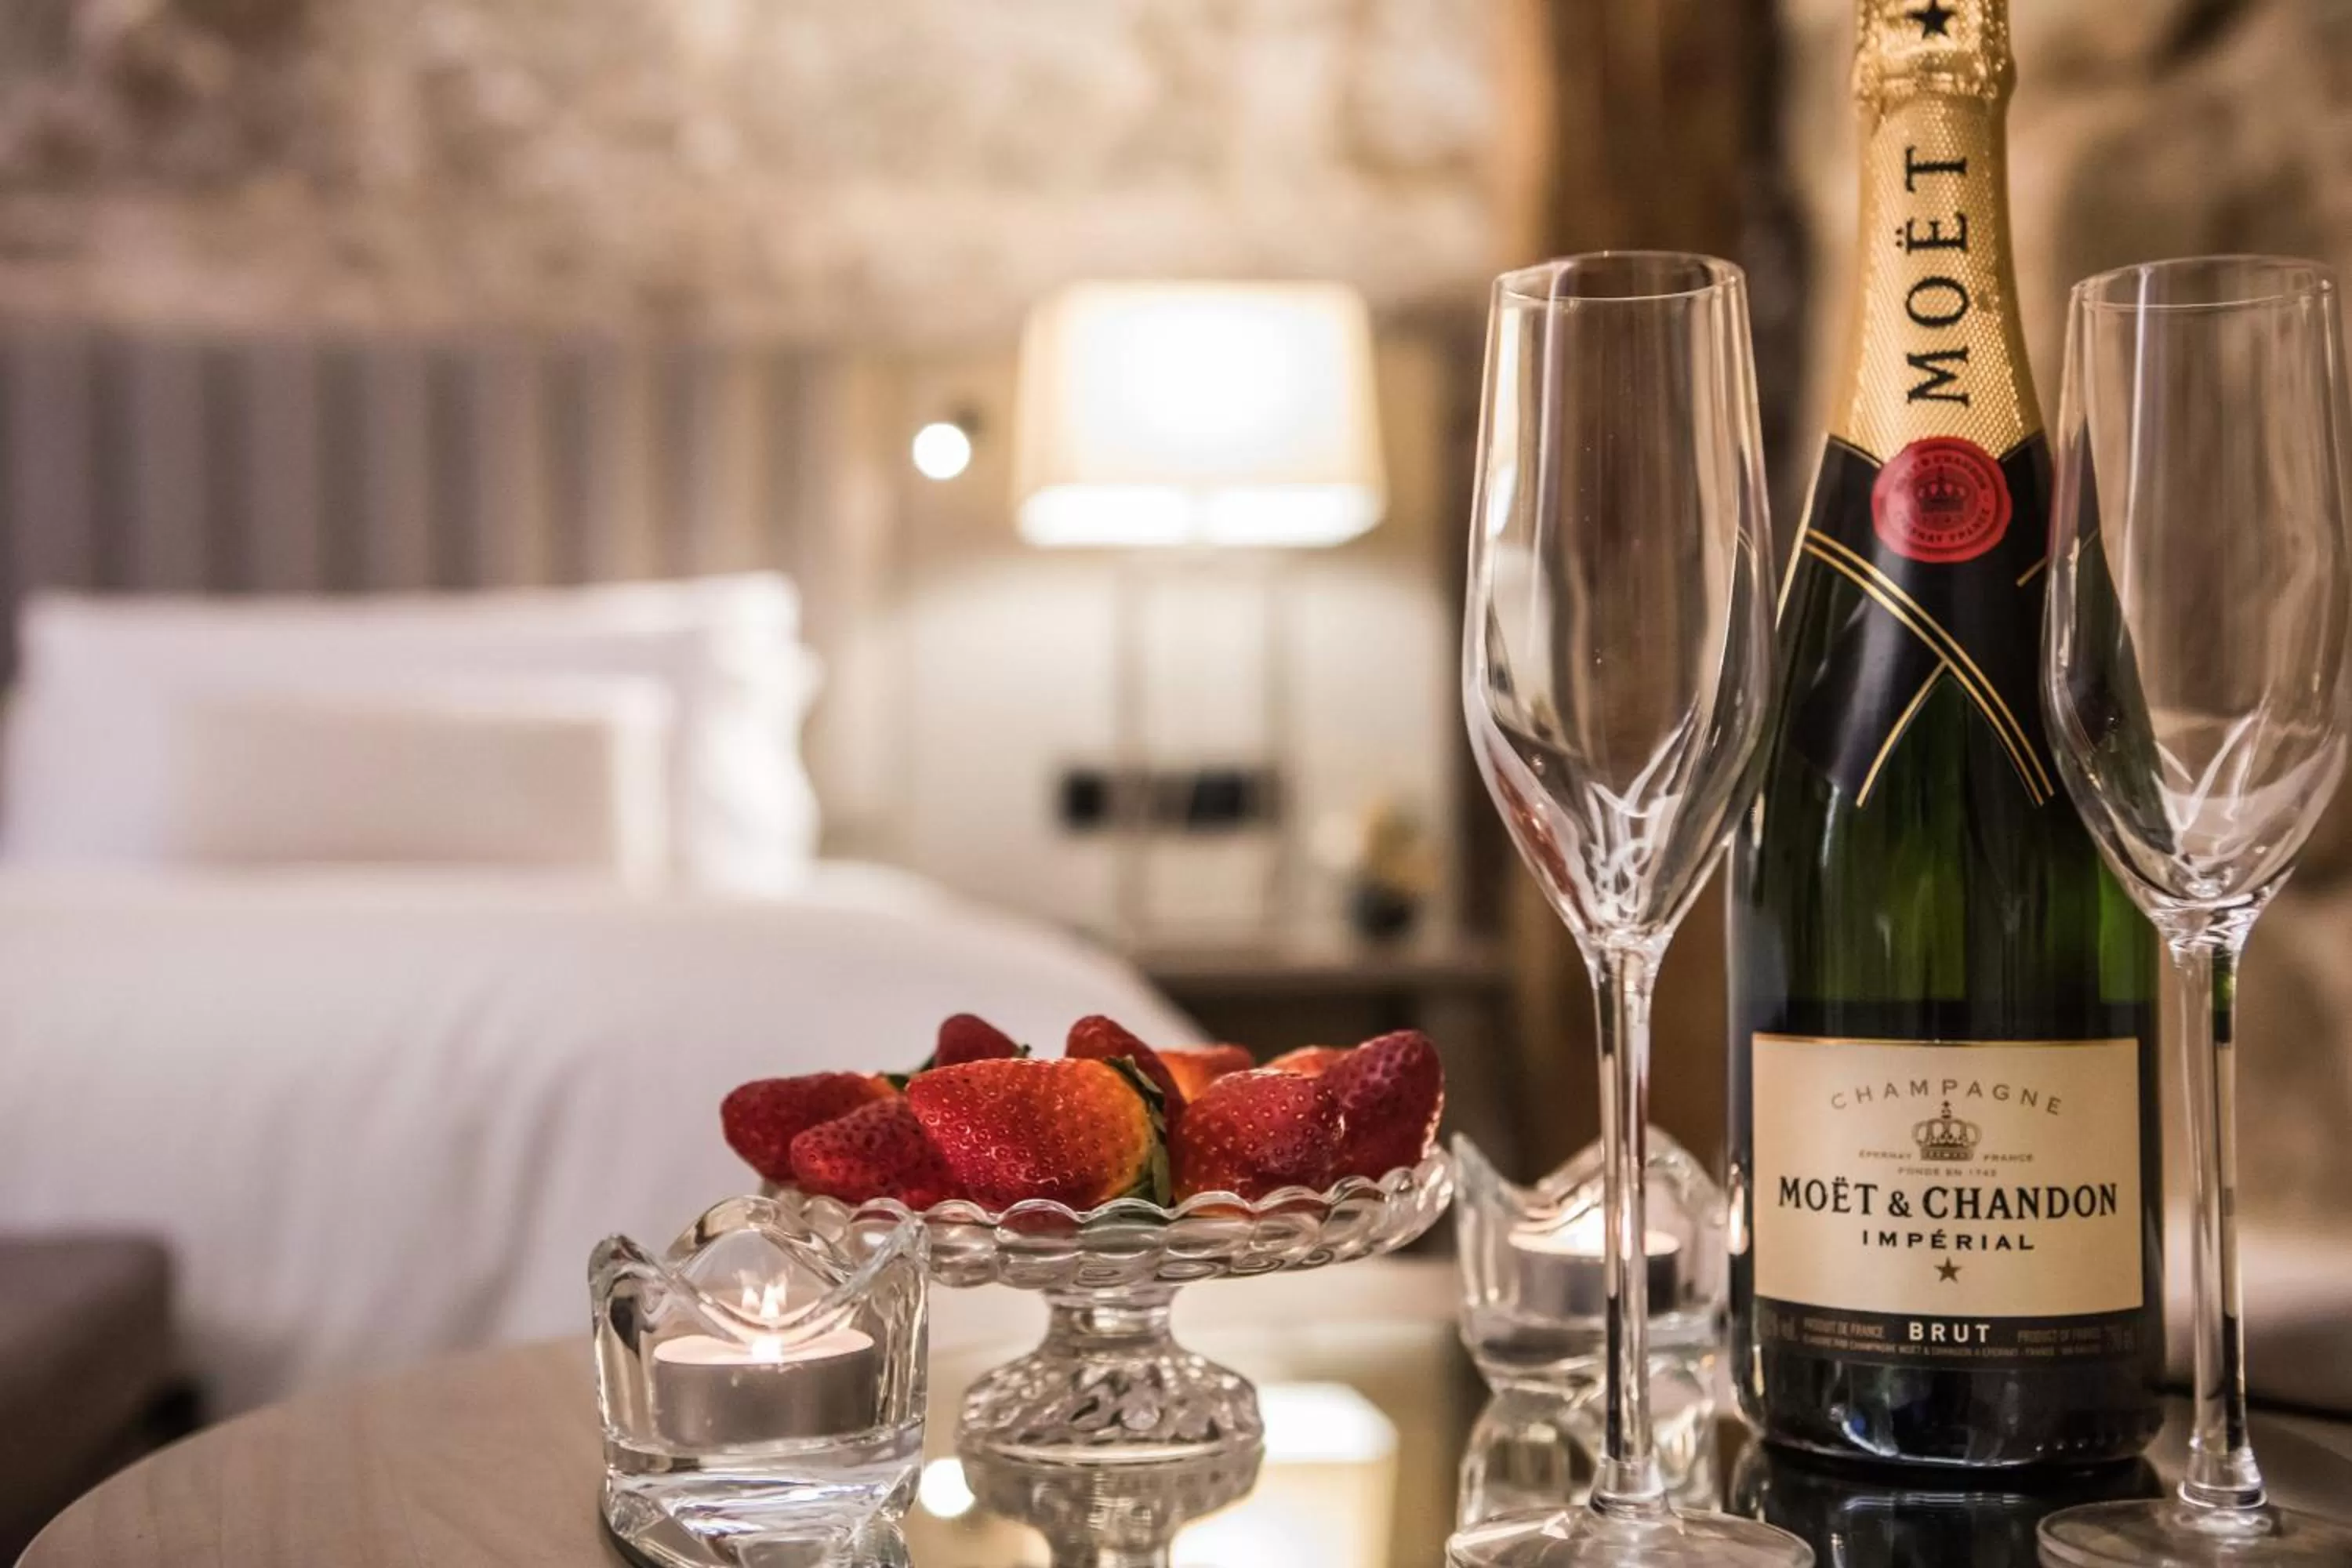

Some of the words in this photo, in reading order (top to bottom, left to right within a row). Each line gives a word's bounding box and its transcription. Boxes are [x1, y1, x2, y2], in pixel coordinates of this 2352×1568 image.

[1896, 146, 1970, 408] MOËT
[1831, 1079, 2061, 1116] CHAMPAGNE
[1779, 1176, 1878, 1215] MOËT
[1888, 1189, 1912, 1218] &
[1922, 1183, 2117, 1221] CHANDON
[1863, 1229, 2034, 1251] IMPÉRIAL
[1909, 1323, 1990, 1343] BRUT
